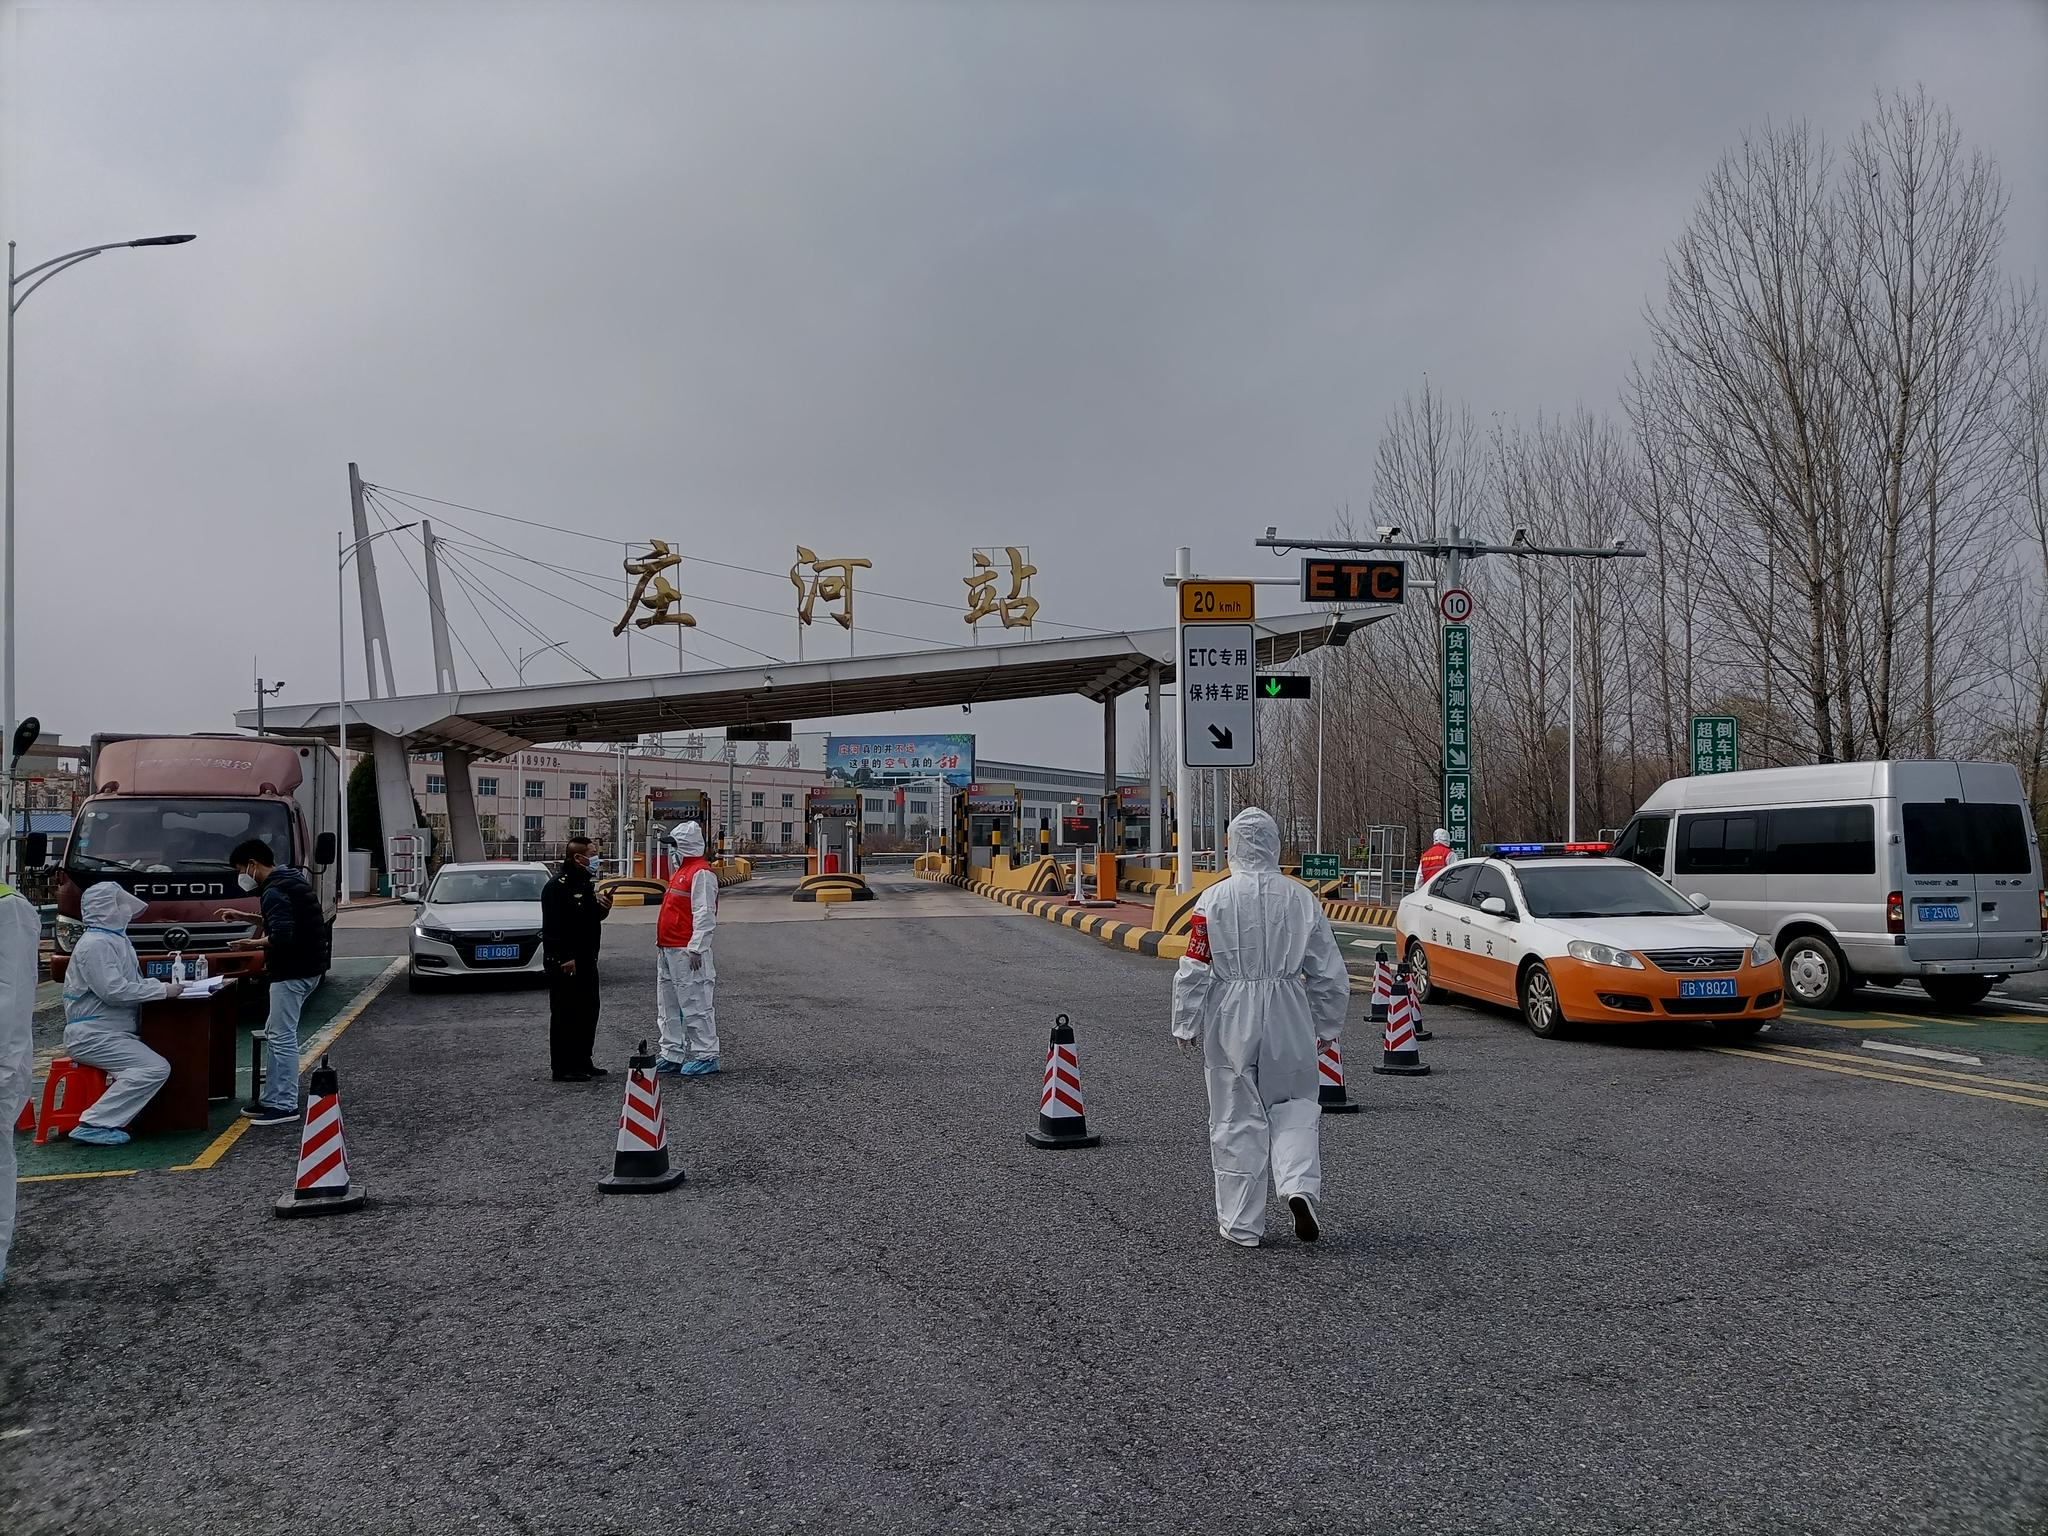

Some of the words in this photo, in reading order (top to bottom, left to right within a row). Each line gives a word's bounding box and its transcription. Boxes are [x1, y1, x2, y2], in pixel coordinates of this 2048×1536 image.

[613, 539, 1040, 637] 庄河站
[1310, 563, 1400, 599] ETC
[1193, 591, 1215, 613] 20
[1219, 601, 1241, 613] km/h
[1449, 599, 1466, 614] 10
[1188, 648, 1248, 667] ETC专用
[1189, 683, 1250, 702] 保持车距
[1448, 631, 1466, 746] 货车检测车道
[1697, 722, 1713, 775] 超限超
[849, 753, 960, 769] 这里的空气真的甜
[133, 883, 224, 896] FOTON
